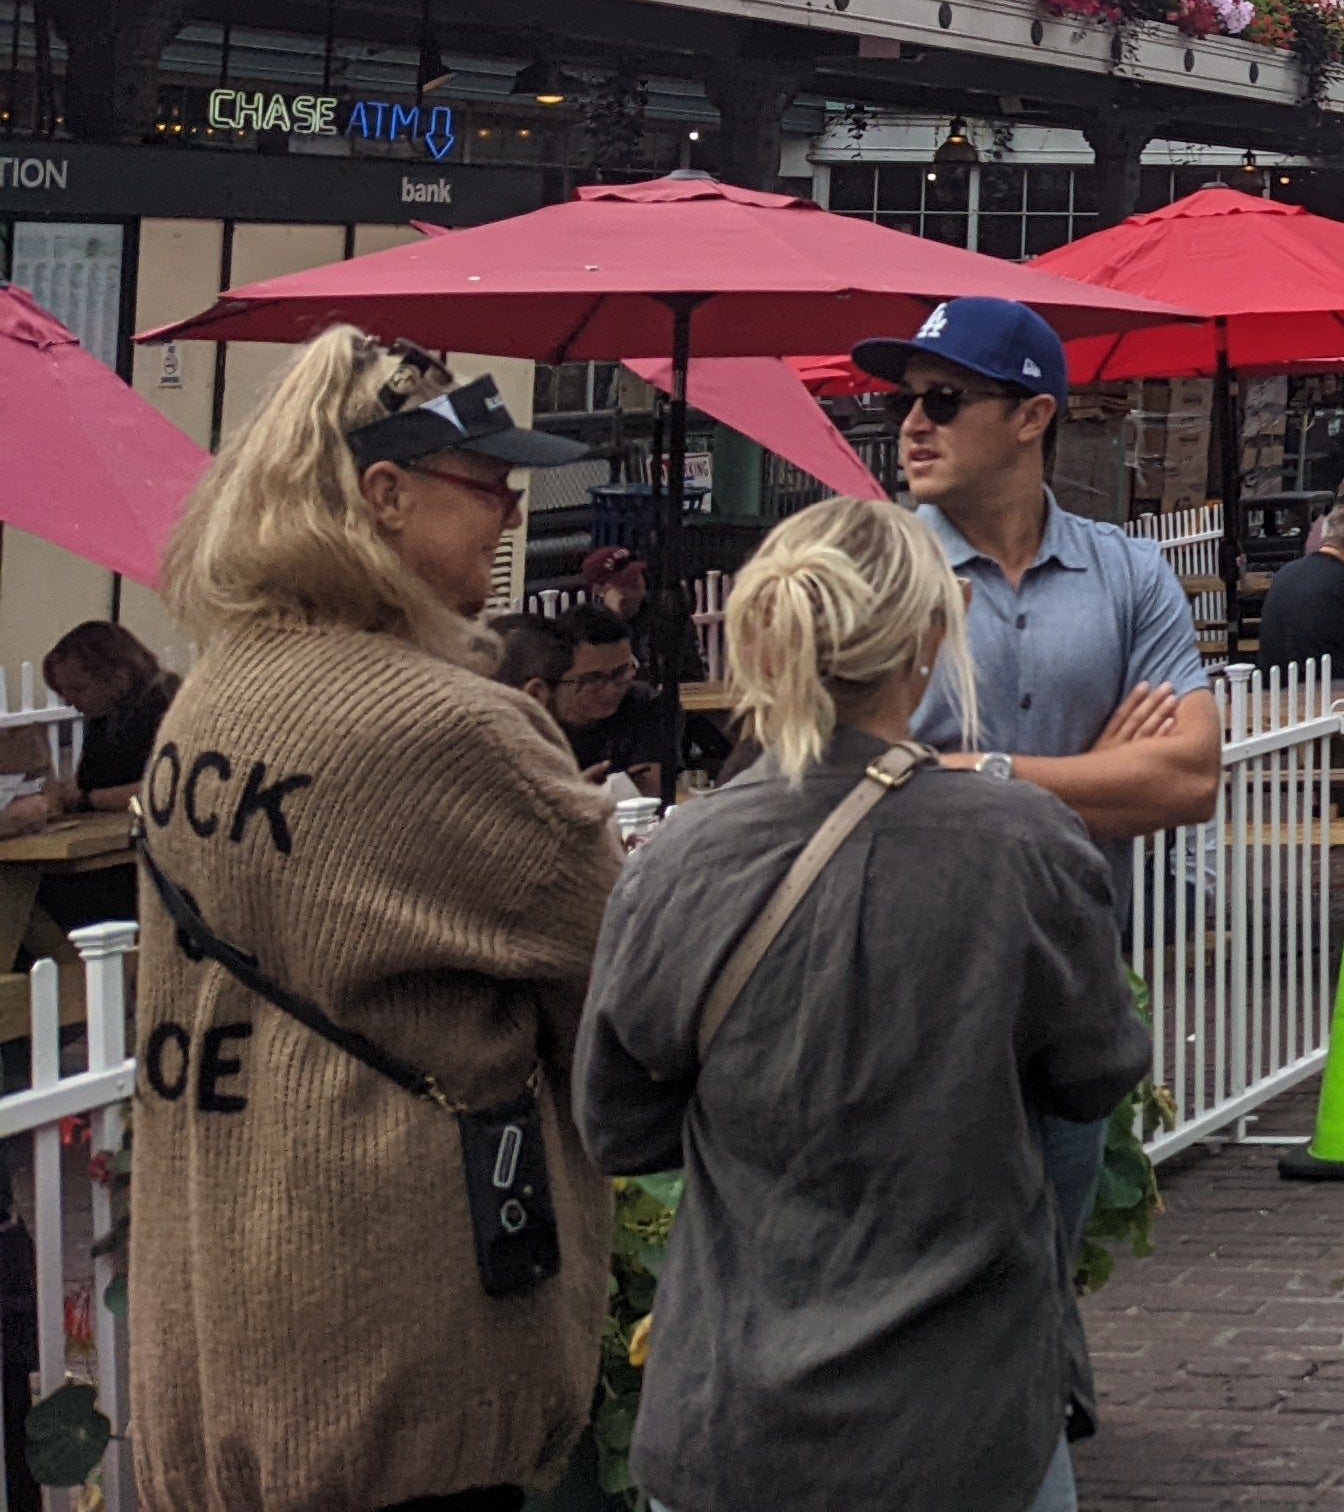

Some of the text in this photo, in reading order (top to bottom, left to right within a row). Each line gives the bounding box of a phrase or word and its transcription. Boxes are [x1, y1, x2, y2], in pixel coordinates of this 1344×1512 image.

[209, 89, 420, 141] CHASE ATM
[0, 156, 69, 189] TION
[402, 176, 452, 204] bank
[149, 741, 313, 855] OCK
[146, 1021, 253, 1113] OE
